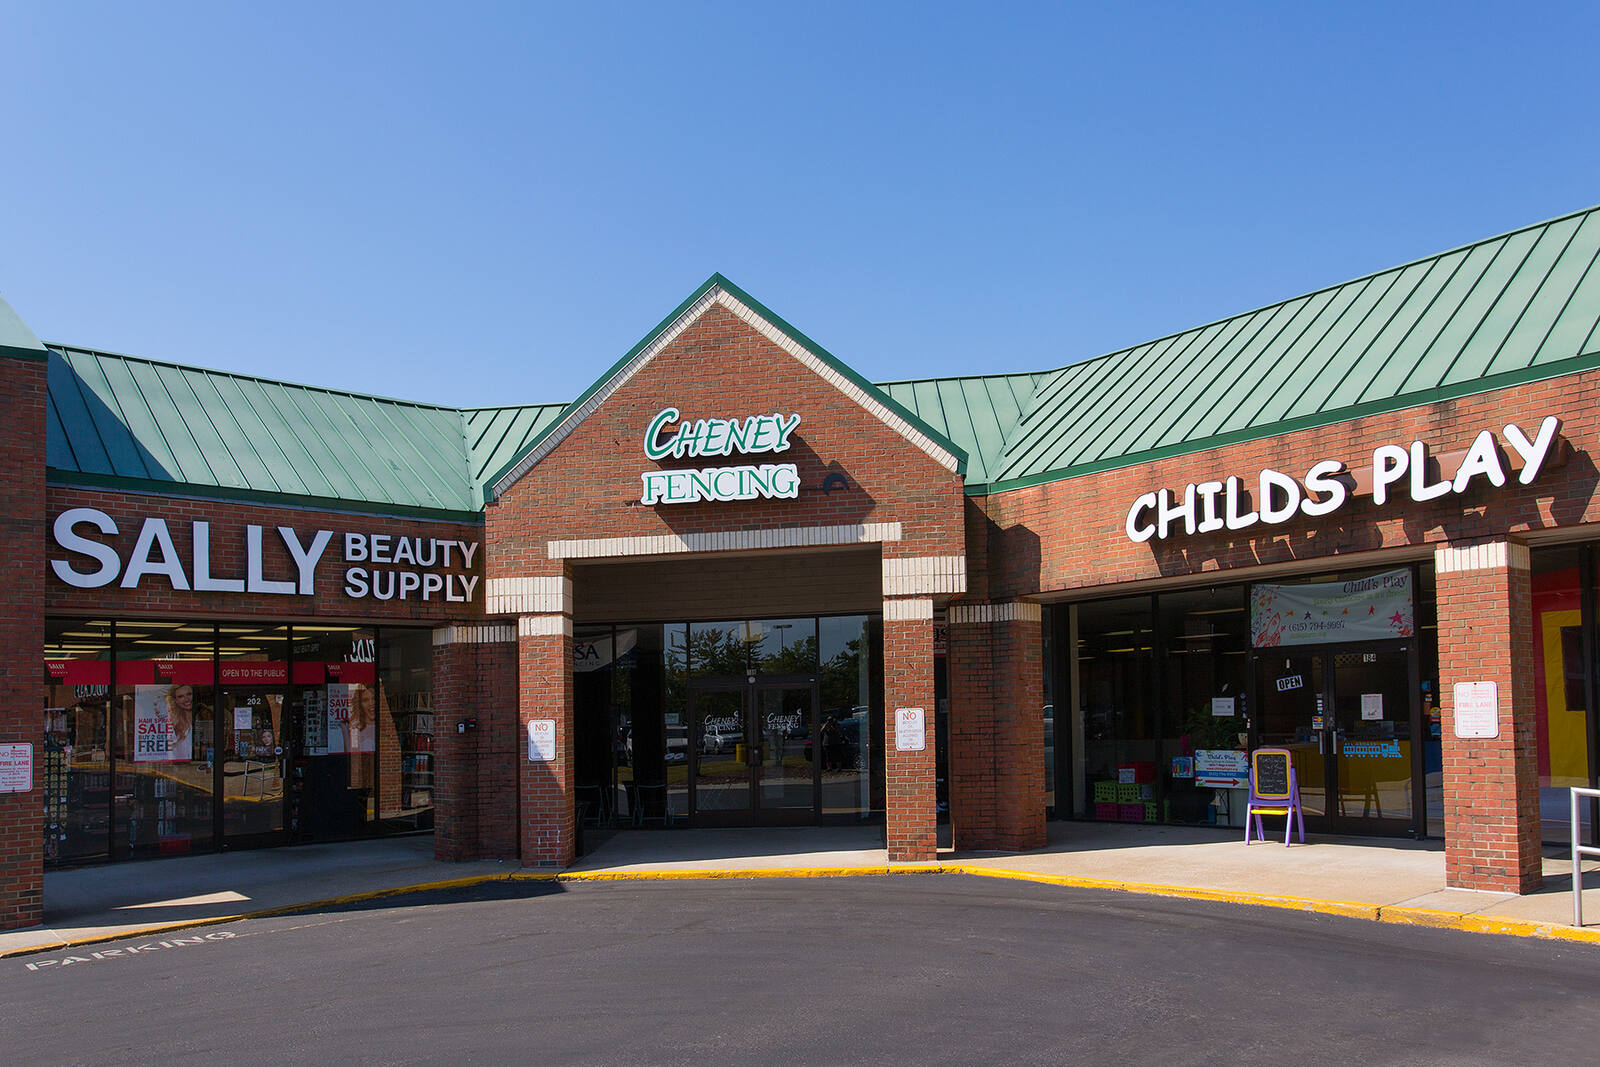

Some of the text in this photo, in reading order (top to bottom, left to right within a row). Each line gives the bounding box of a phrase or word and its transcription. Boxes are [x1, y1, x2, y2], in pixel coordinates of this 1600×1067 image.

[645, 408, 800, 459] CHENEY
[642, 466, 798, 504] FENCING
[1125, 415, 1562, 543] CHILDS PLAY
[51, 508, 334, 595] SALLY
[345, 533, 479, 569] BEAUTY
[345, 567, 479, 603] SUPPLY
[1343, 575, 1408, 594] Child's Play
[1288, 621, 1307, 632] (615)
[222, 668, 286, 678] OPEN TO THE PUBLIC
[1278, 675, 1301, 690] OPEN
[247, 697, 262, 706] 202
[902, 711, 917, 721] NO
[138, 723, 175, 734] SALE
[535, 723, 549, 732] NO
[138, 740, 174, 752] FREE
[25, 931, 236, 971] PARKING
